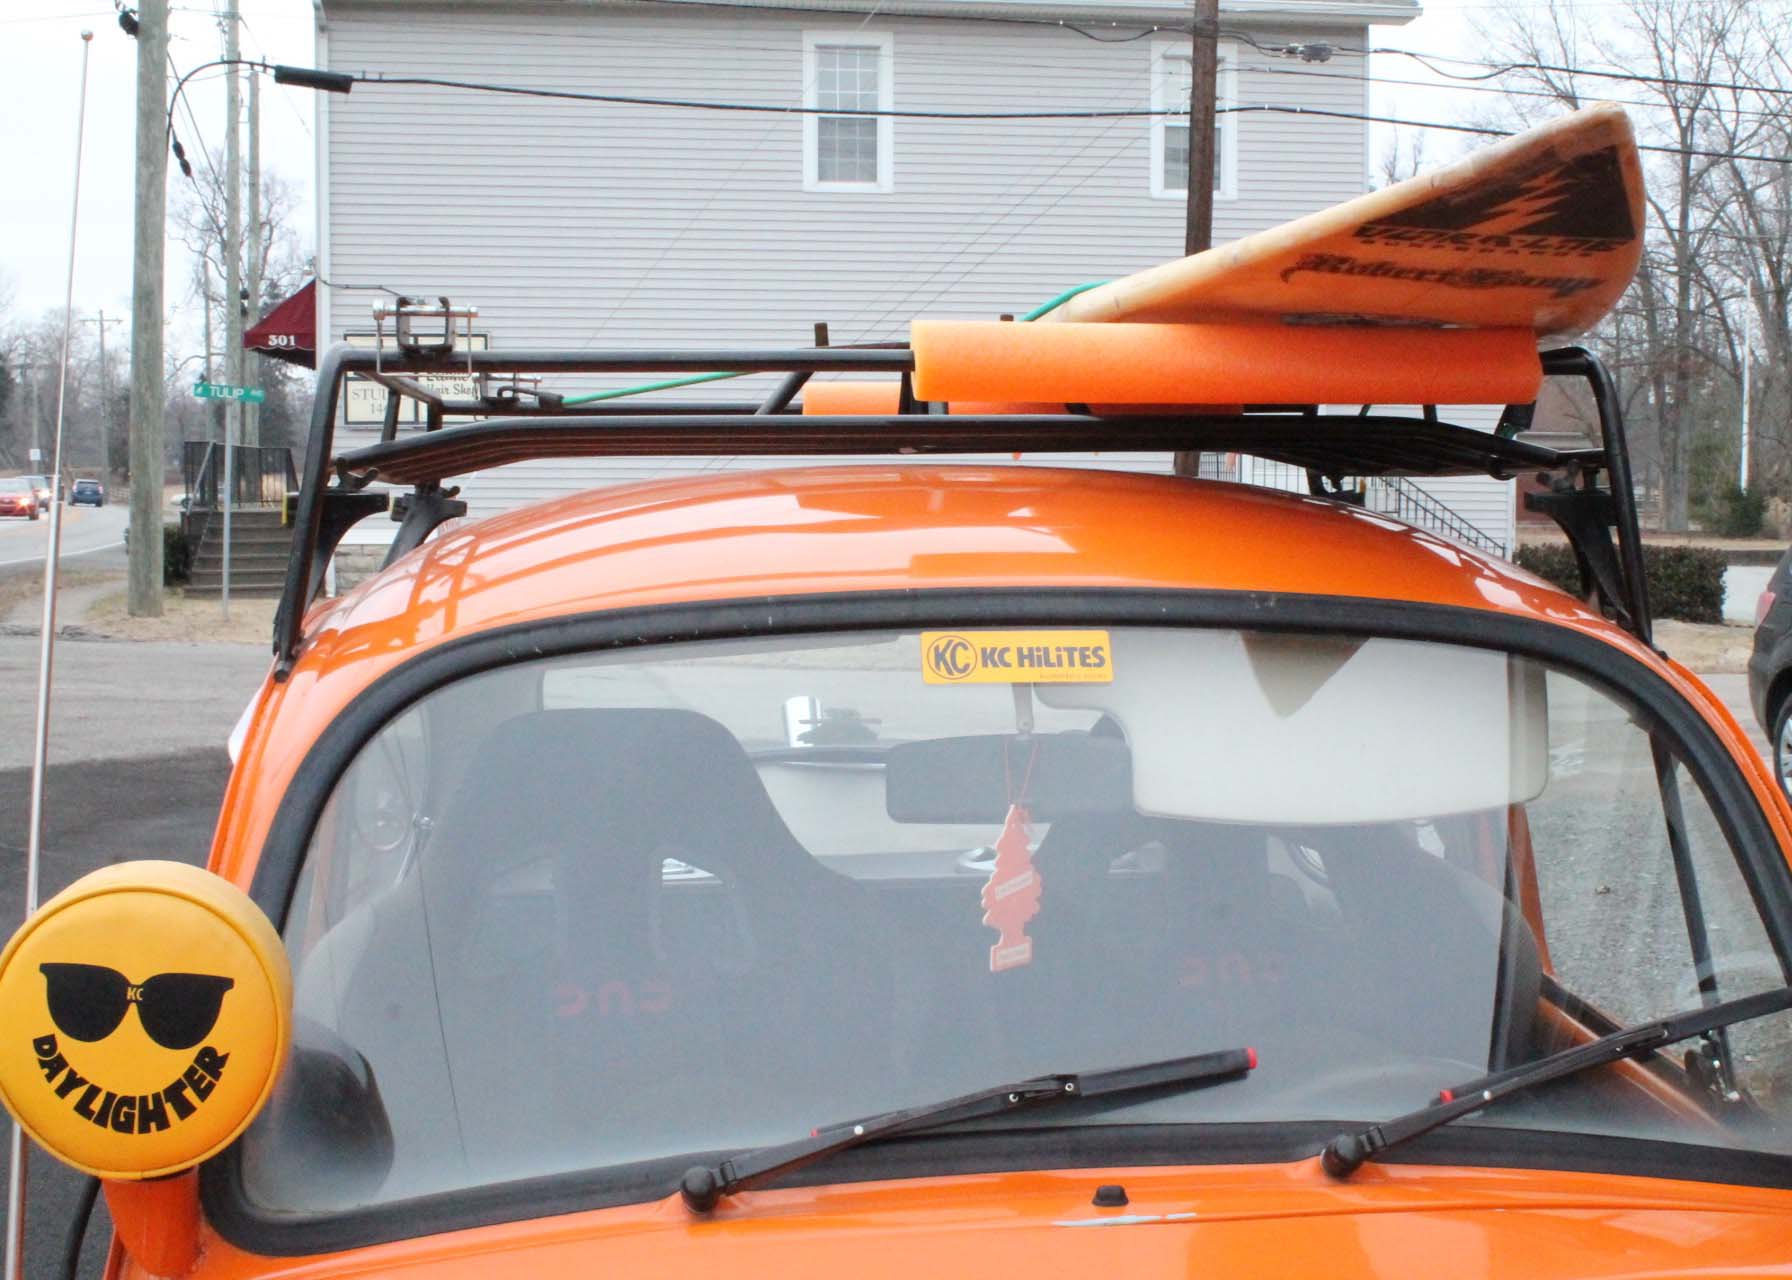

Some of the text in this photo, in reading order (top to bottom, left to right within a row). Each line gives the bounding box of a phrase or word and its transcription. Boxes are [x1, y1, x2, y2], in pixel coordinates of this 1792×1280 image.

[209, 386, 245, 398] TULIP
[934, 639, 972, 677] KC
[981, 647, 1013, 668] KC
[126, 986, 144, 1001] KC
[32, 1033, 231, 1135] DAYLIGHTER
